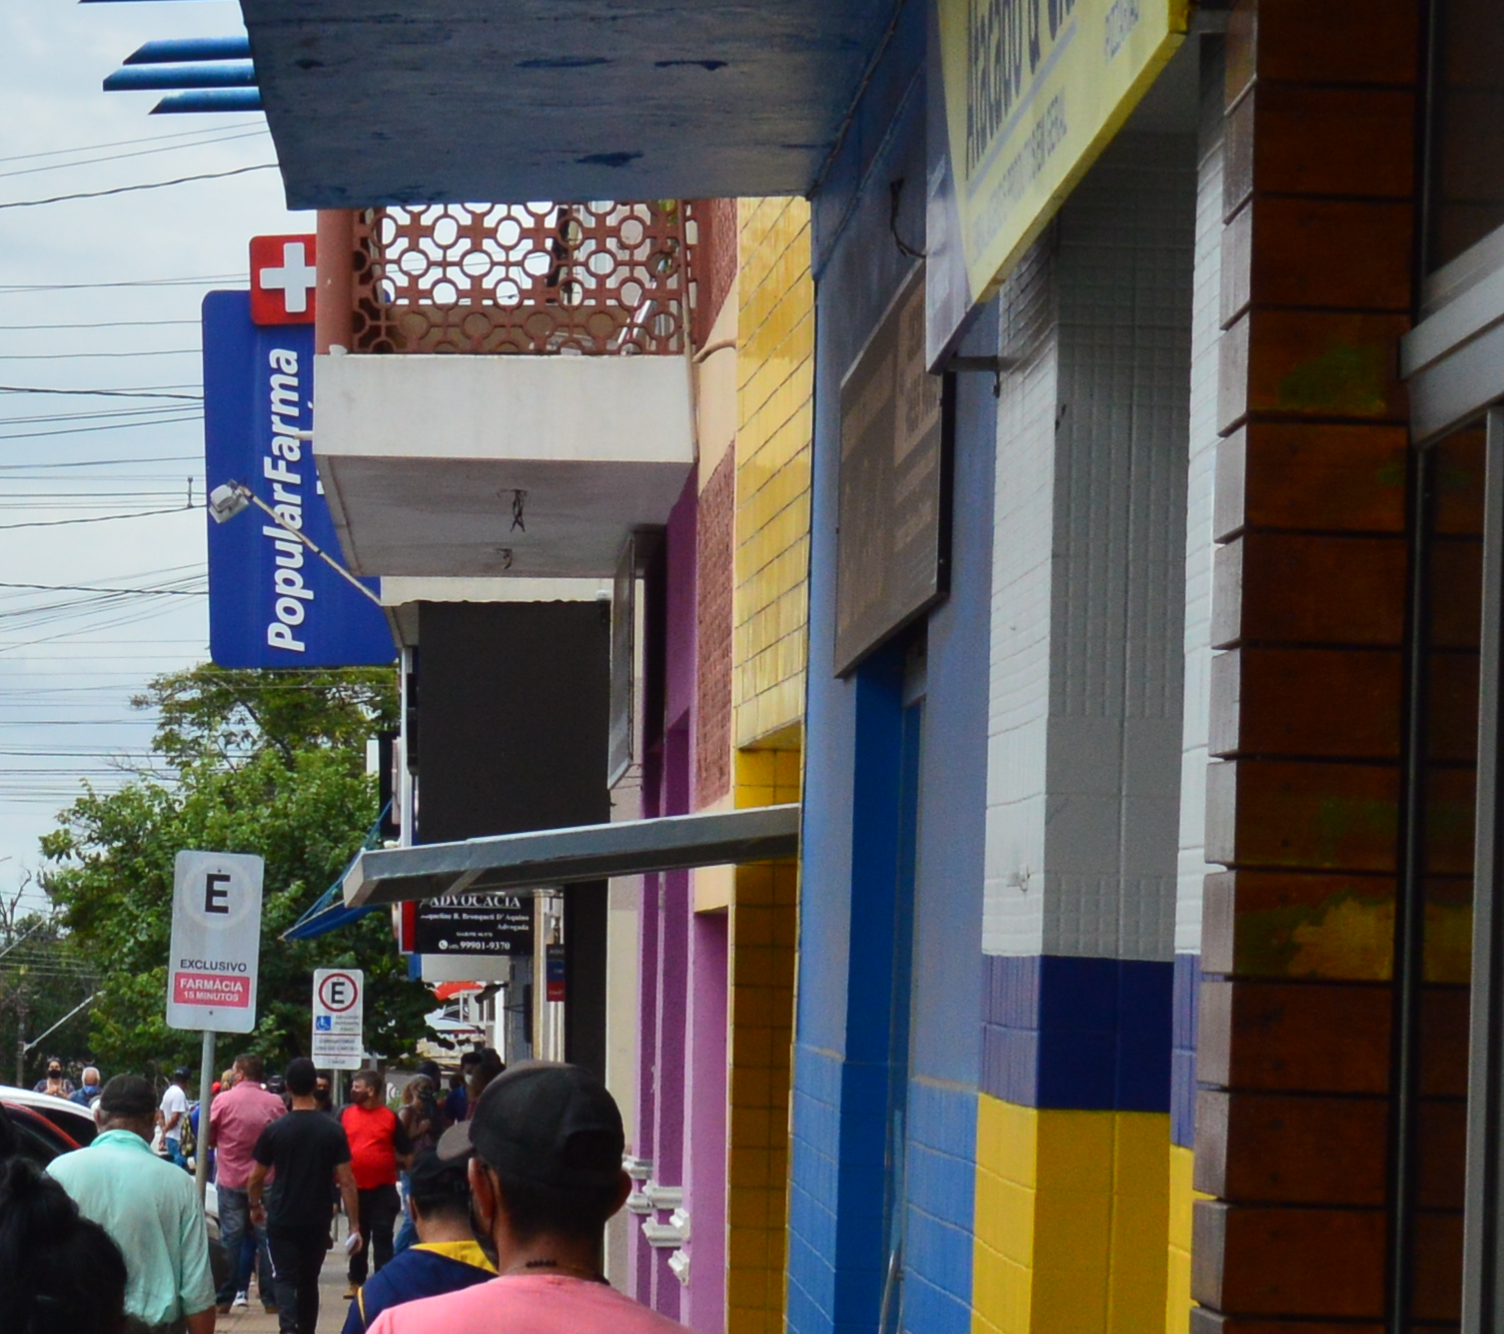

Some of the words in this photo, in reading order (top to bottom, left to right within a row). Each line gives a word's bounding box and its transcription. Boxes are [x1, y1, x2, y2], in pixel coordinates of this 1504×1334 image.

[262, 348, 315, 652] PopularFarma
[204, 873, 231, 914] E
[429, 895, 521, 908] ADVOCACIA
[180, 959, 247, 973] EXCLUSIVO
[180, 977, 244, 992] FARMÁCIA
[184, 990, 195, 999] 15
[195, 991, 239, 1002] MINUTOS
[331, 981, 346, 1005] E
